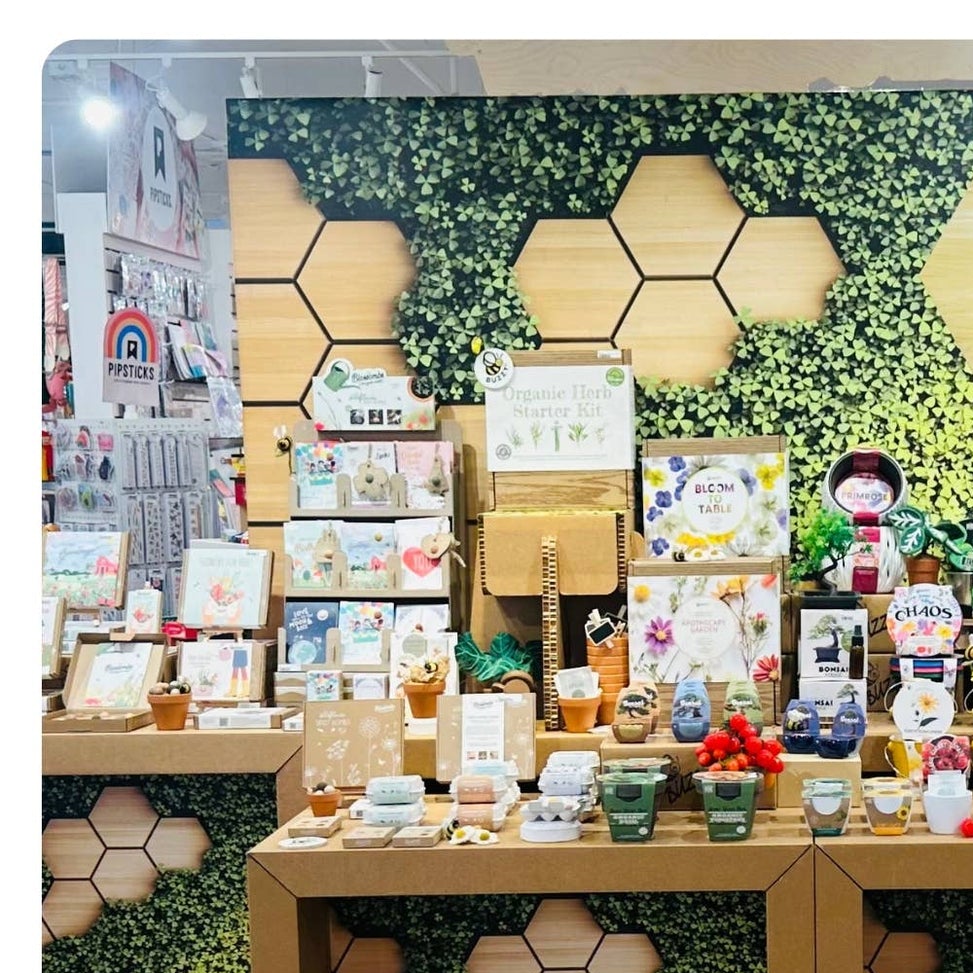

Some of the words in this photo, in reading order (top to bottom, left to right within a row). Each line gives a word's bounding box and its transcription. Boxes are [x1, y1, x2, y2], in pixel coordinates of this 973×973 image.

[108, 362, 155, 380] PIPSTICKS
[502, 384, 566, 402] Organic
[572, 384, 613, 401] Herb
[512, 404, 572, 418] Starter
[576, 402, 602, 418] Kit
[694, 482, 735, 494] BLOOM
[697, 503, 733, 514] TABLE
[894, 604, 953, 622] CHAOS
